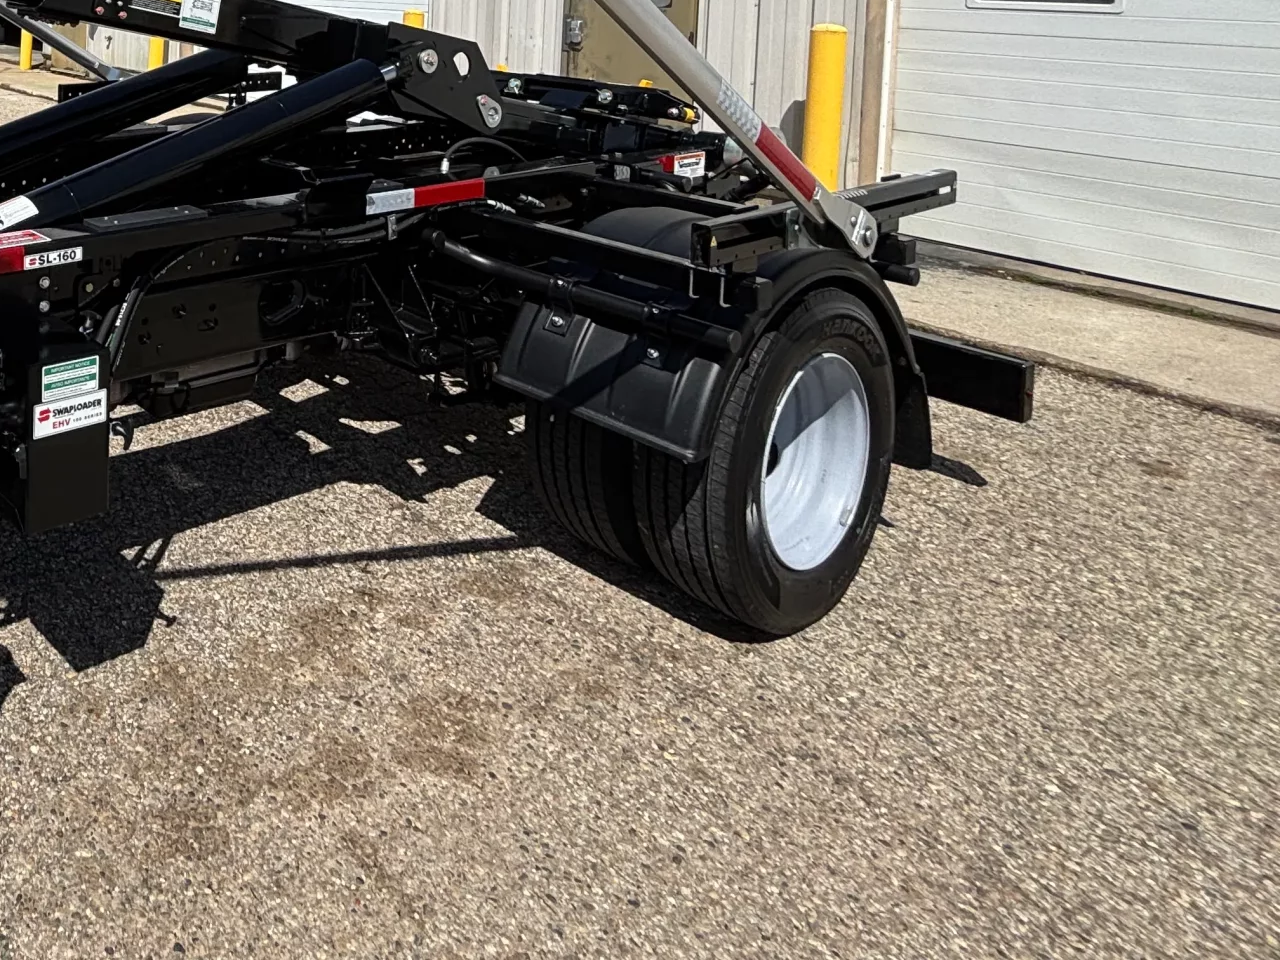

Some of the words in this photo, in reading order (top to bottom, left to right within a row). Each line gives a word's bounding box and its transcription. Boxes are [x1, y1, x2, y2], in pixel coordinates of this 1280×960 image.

[37, 250, 77, 265] SL-160
[52, 398, 102, 417] SWAPLOADER
[52, 418, 71, 429] EHV
